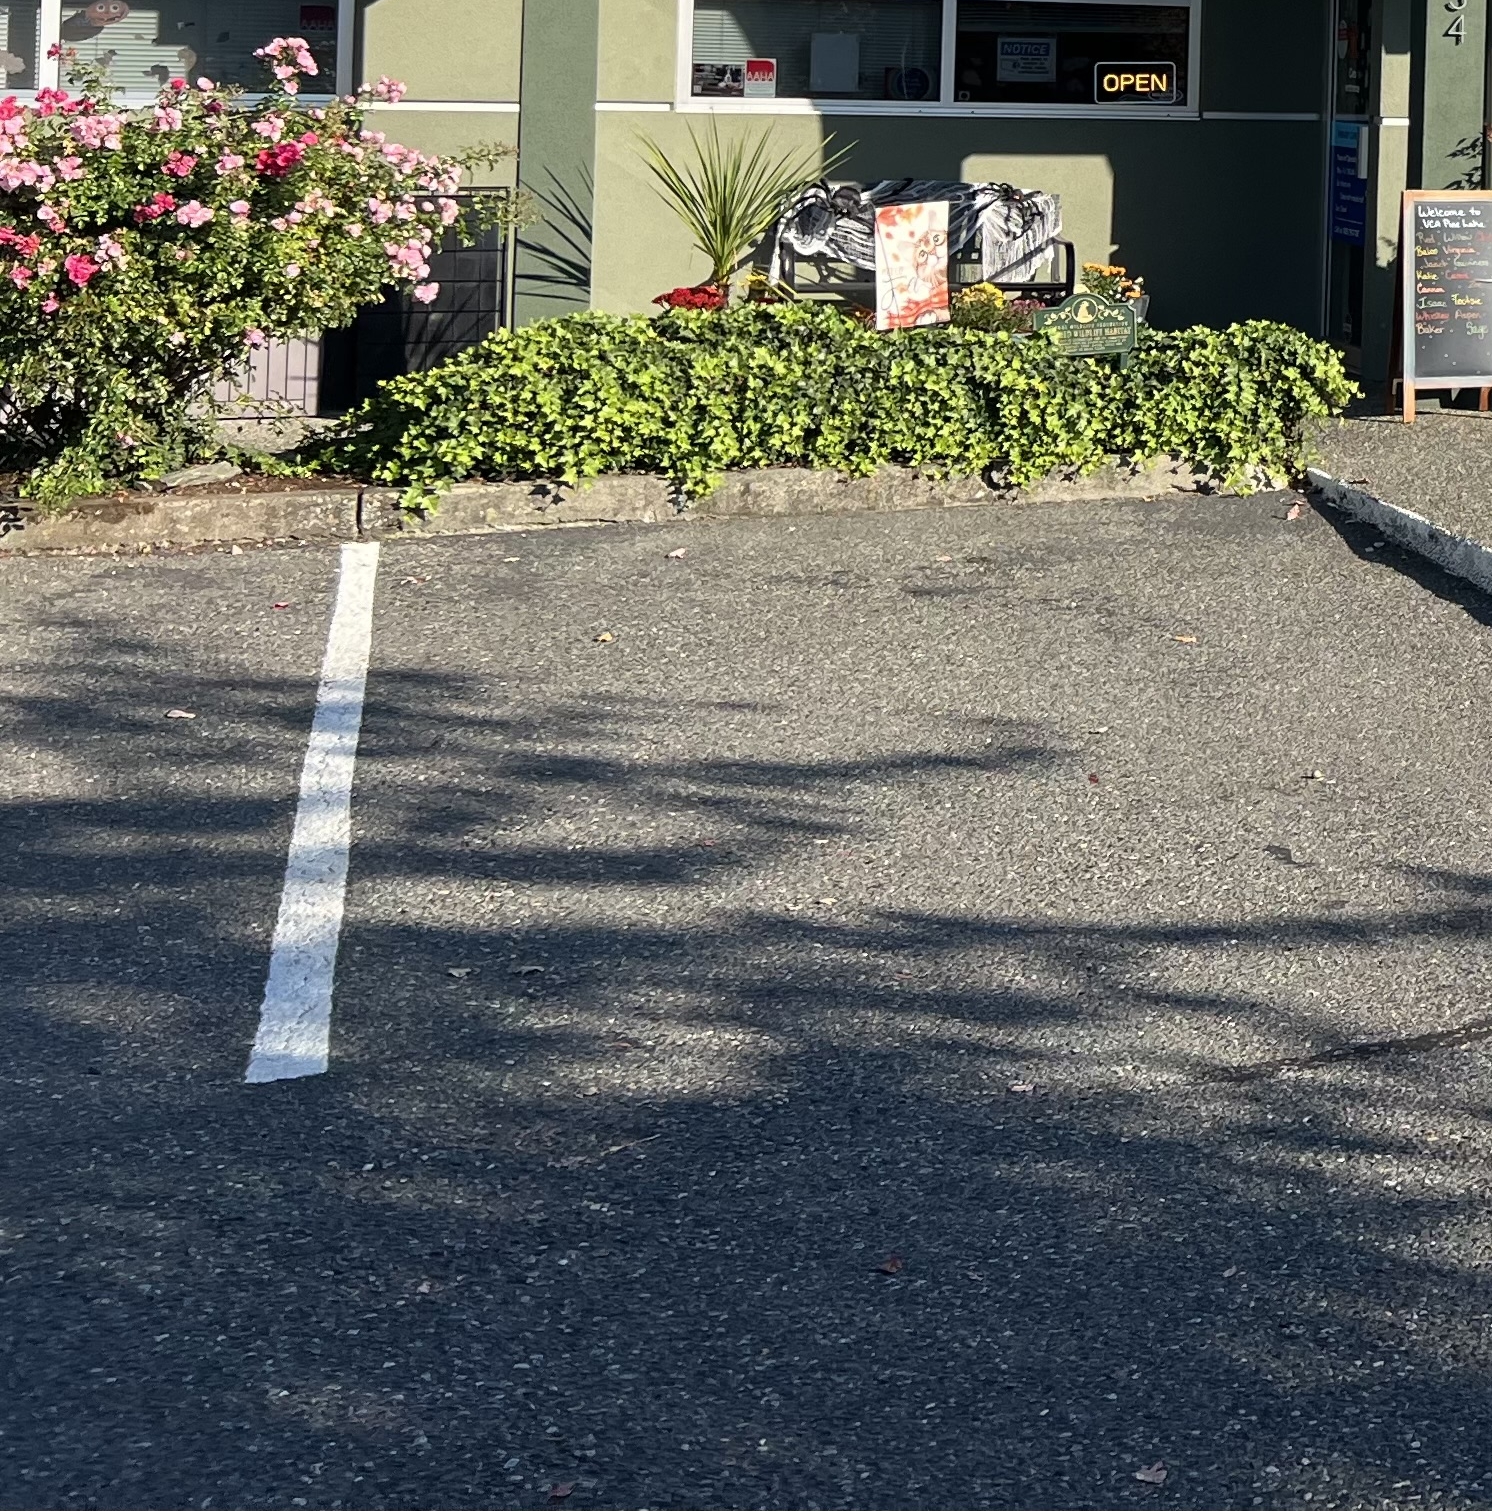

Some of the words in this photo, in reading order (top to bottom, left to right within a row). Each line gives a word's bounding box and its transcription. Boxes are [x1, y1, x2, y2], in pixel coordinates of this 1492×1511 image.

[1002, 43, 1048, 55] NOTICE
[746, 71, 775, 82] AAHA
[1103, 73, 1168, 93] OPEN
[1417, 205, 1467, 218] Welcome
[1469, 206, 1481, 216] to
[1422, 219, 1441, 228] VCA
[1415, 322, 1444, 335] Baker
